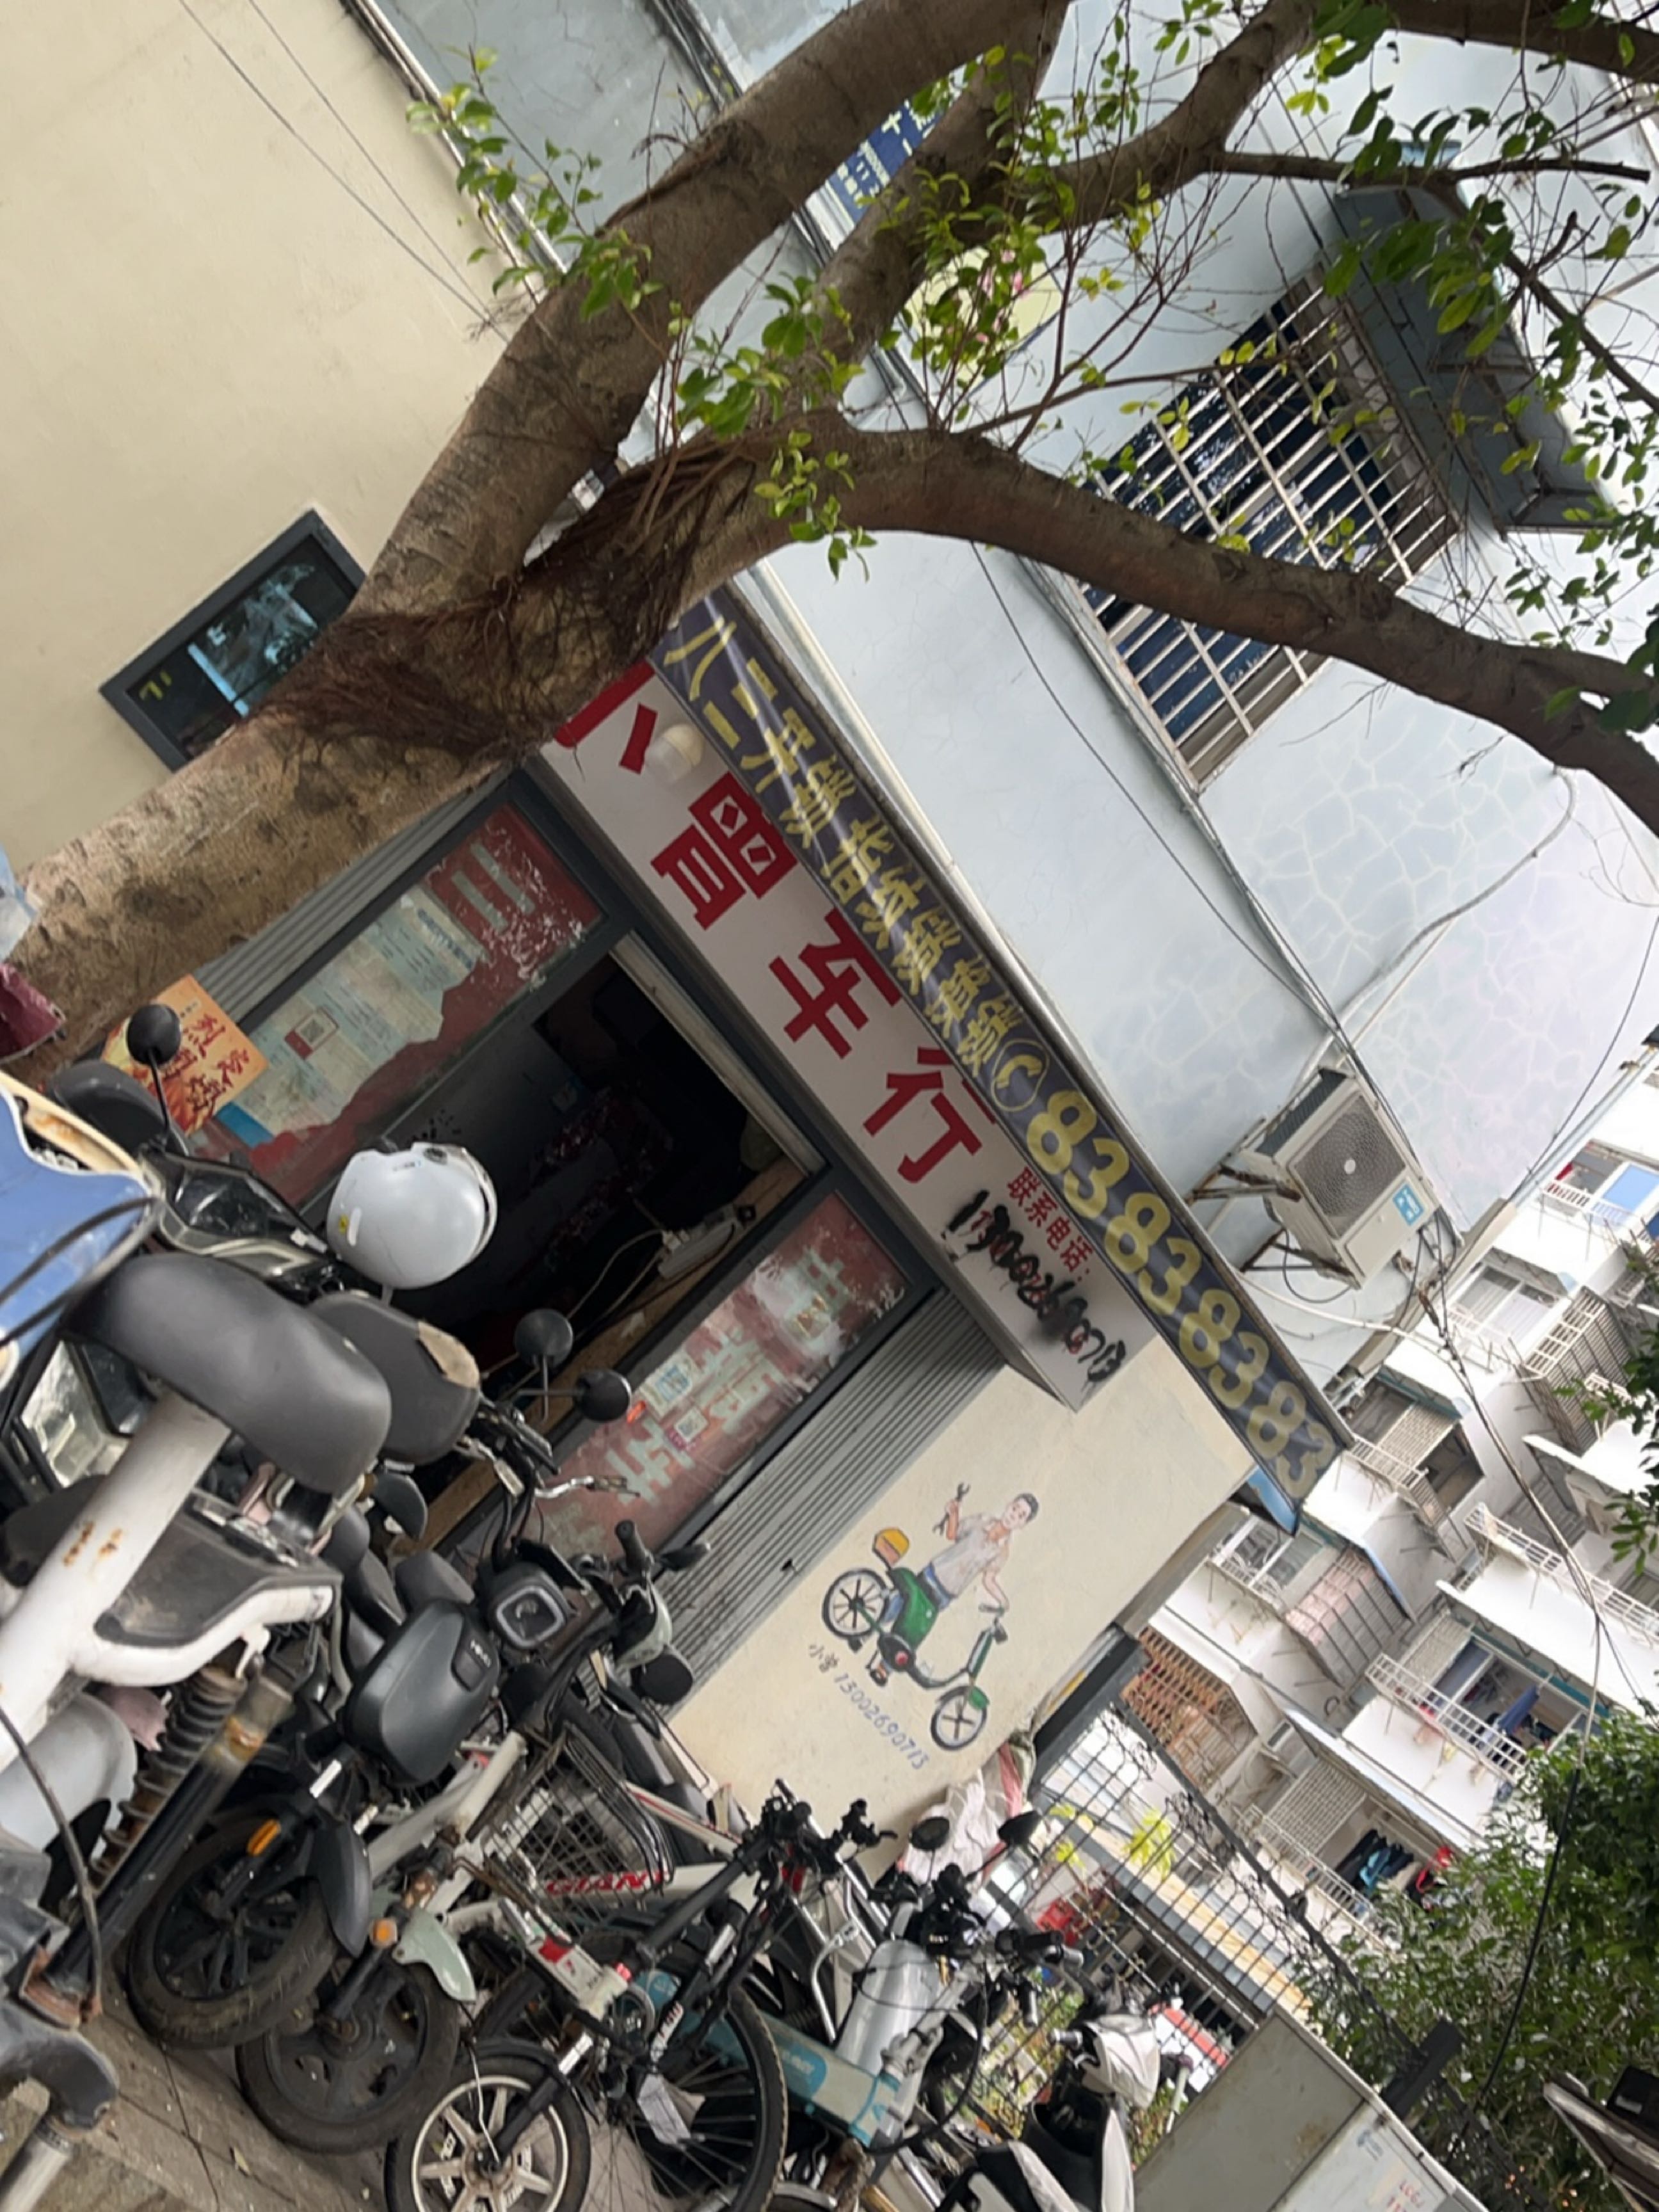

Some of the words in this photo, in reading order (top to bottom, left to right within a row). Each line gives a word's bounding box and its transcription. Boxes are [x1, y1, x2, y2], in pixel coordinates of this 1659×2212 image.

[554, 657, 997, 1184] 小曾车行
[1027, 1089, 1336, 1499] 83838383
